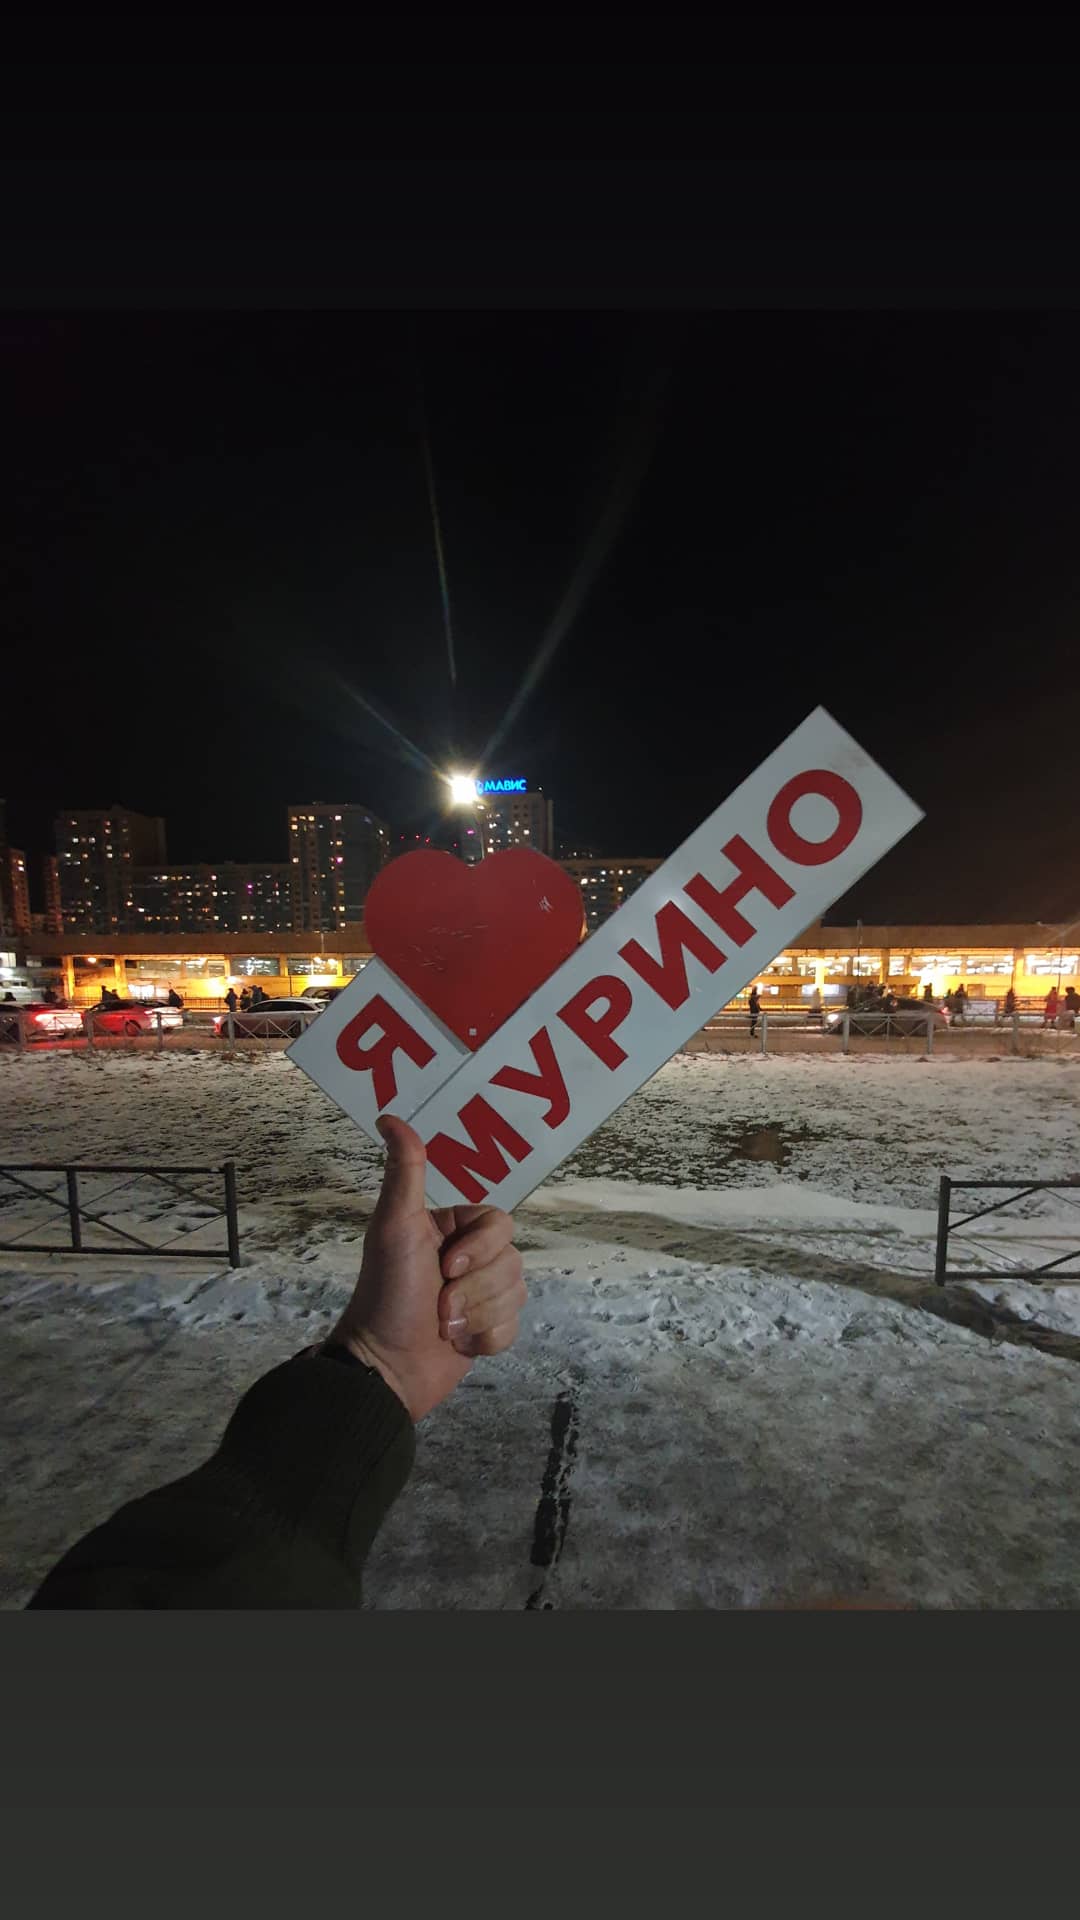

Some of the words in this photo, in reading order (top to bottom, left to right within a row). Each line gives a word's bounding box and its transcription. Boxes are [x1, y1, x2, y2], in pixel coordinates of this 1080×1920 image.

[484, 779, 527, 791] МАВИС
[426, 769, 863, 1204] МУРИНО
[336, 994, 437, 1112] Я
